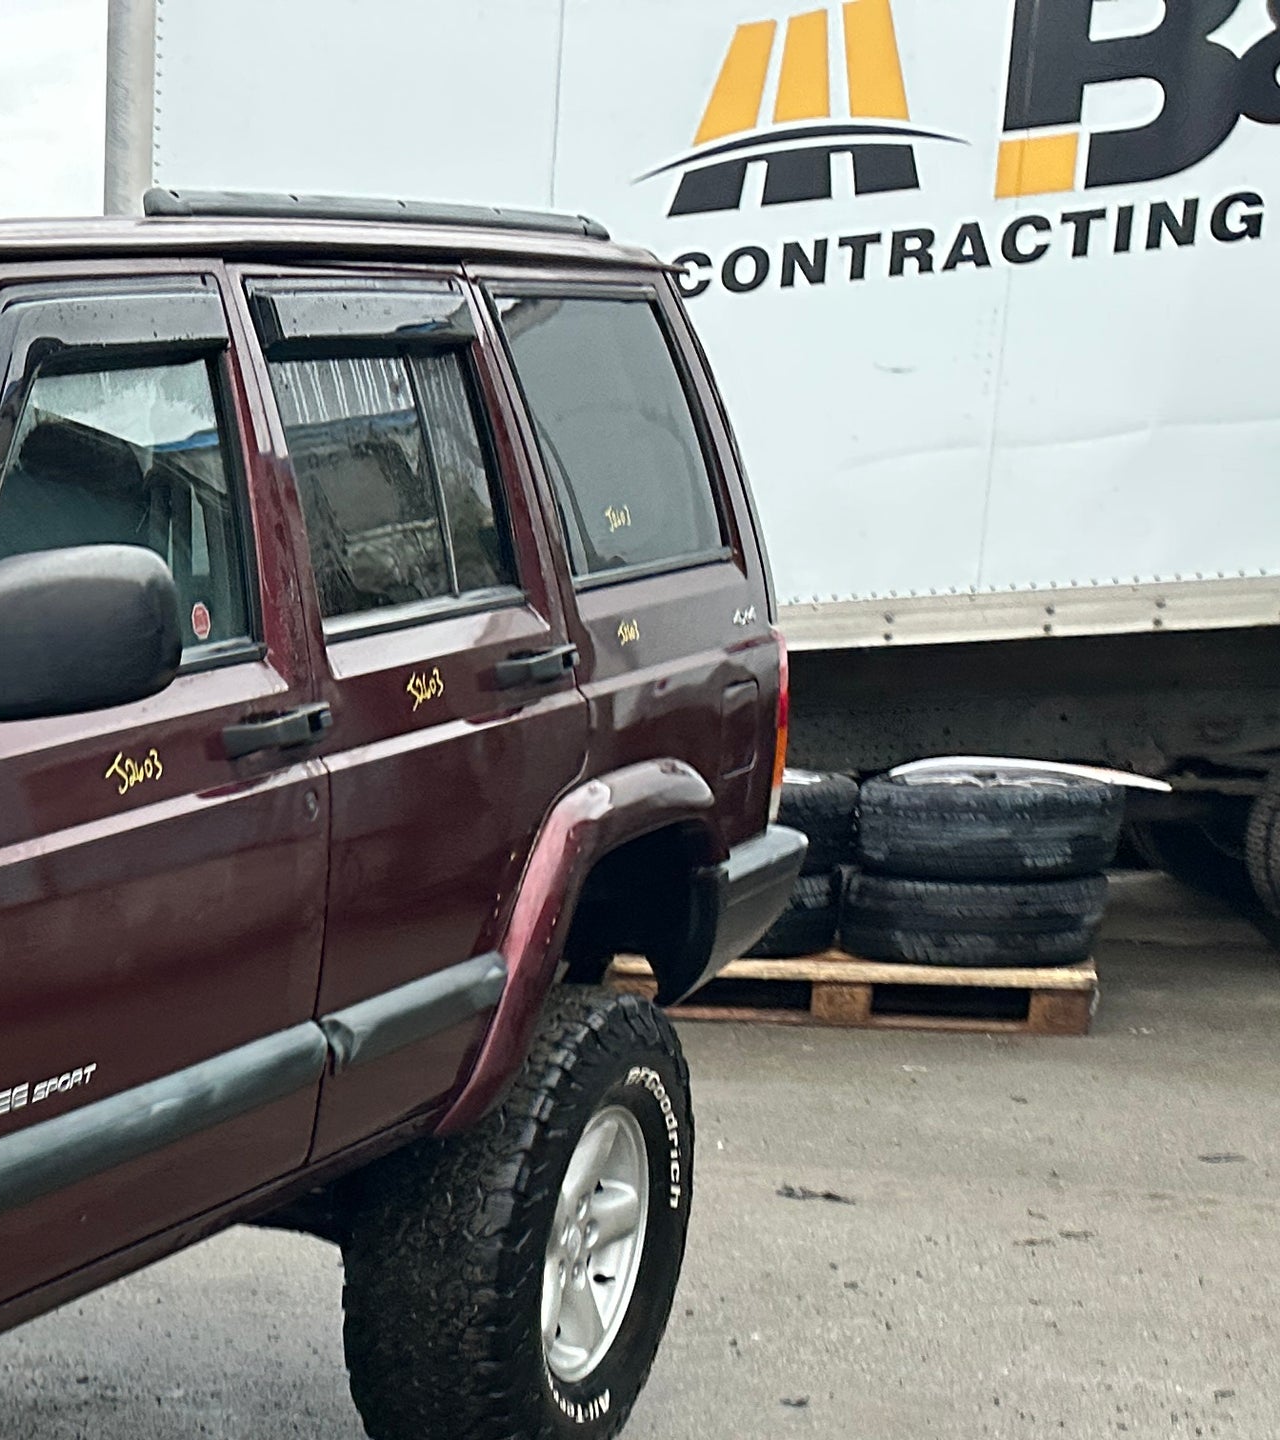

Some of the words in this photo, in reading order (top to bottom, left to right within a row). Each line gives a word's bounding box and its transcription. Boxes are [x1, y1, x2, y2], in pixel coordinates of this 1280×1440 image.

[995, 0, 1280, 198] B
[671, 191, 1265, 298] CONTRACTING
[31, 1062, 97, 1104] SPORT
